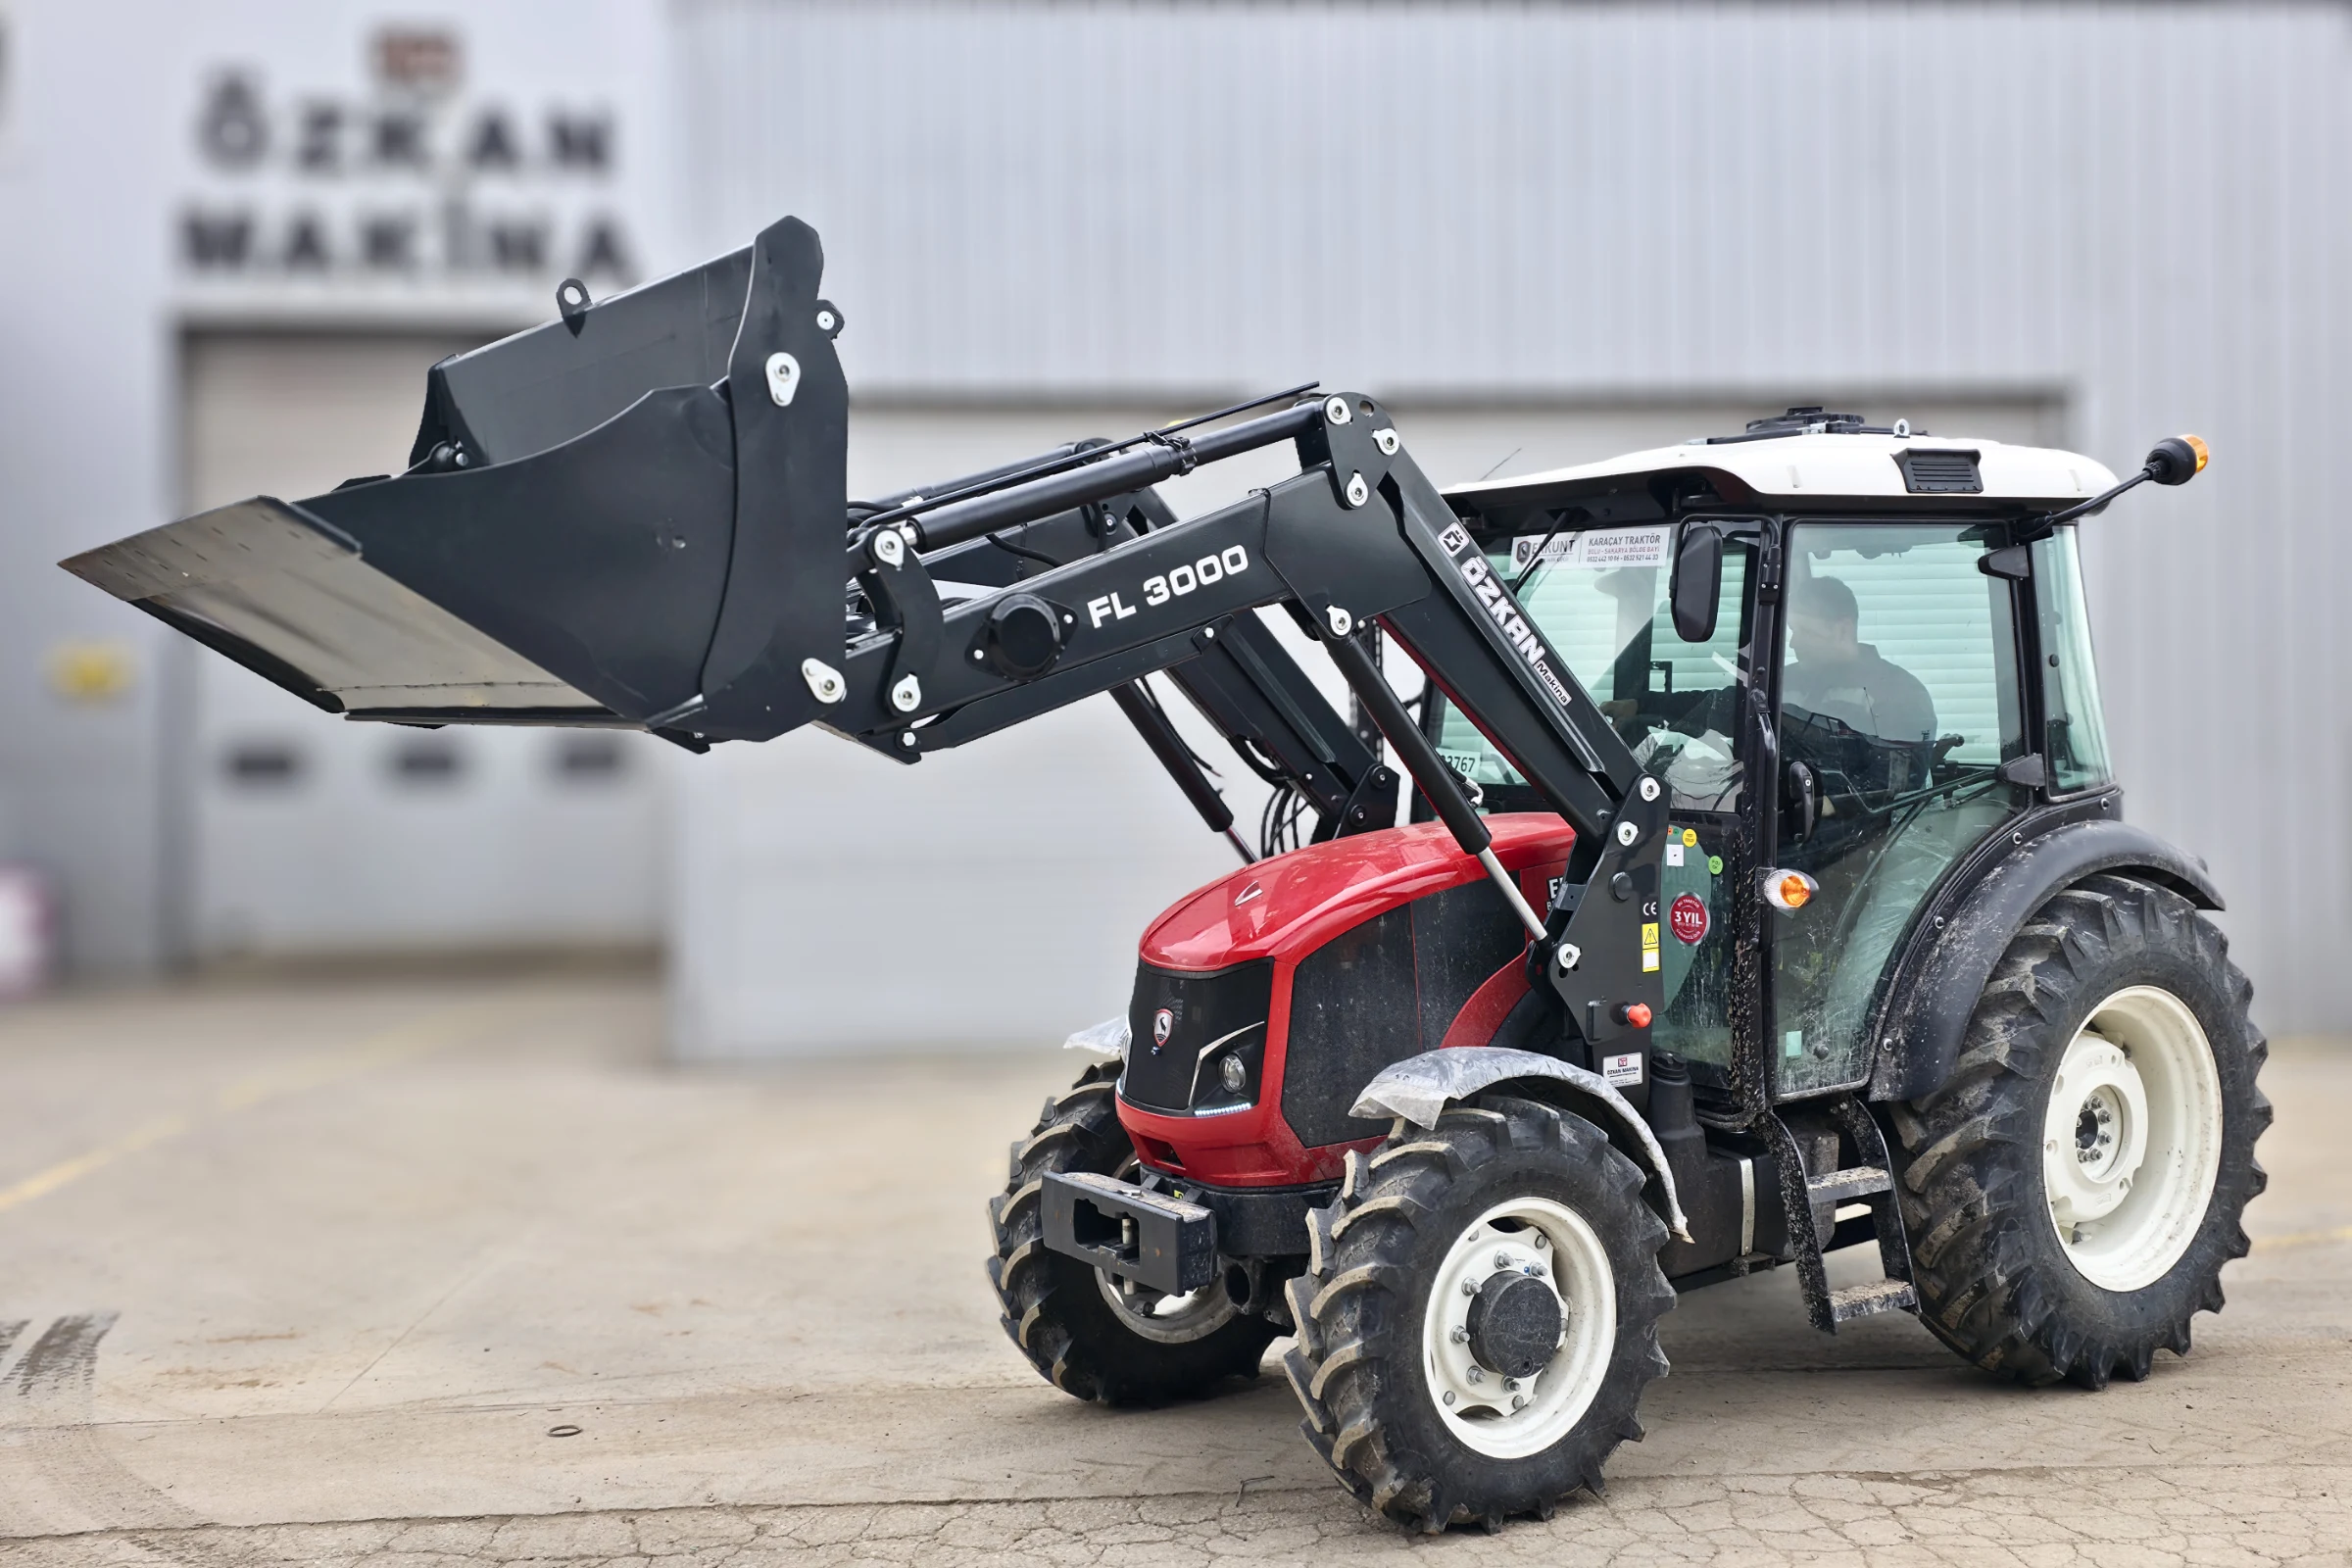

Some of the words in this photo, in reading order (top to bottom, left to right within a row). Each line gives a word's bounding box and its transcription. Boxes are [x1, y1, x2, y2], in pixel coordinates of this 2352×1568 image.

[199, 71, 613, 172] ÖZKAN
[182, 202, 641, 278] MAKİNA
[1589, 536, 1623, 547] KARAÇAY
[1625, 532, 1661, 545] TRAKTÖR
[1087, 592, 1137, 628] FL
[1143, 544, 1249, 606] 3000
[1460, 556, 1545, 666] ÖZKAN
[1536, 662, 1568, 705] Makina
[1674, 910, 1682, 922] 3
[1683, 911, 1703, 925] YIL
